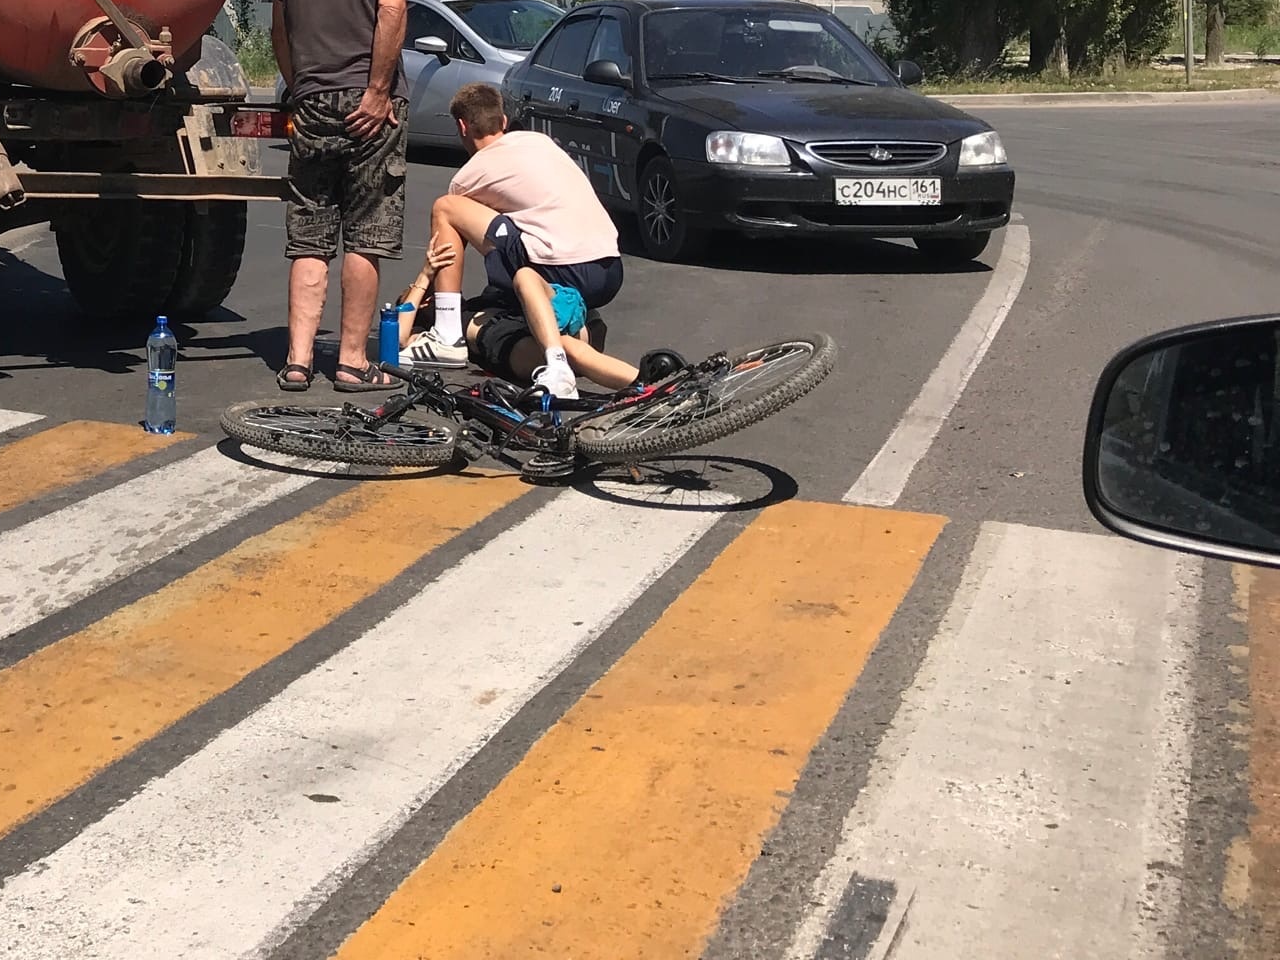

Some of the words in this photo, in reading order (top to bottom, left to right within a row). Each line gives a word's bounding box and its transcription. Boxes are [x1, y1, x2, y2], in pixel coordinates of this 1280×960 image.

[548, 86, 564, 103] 204
[840, 181, 908, 199] С204НС
[912, 180, 937, 194] 161
